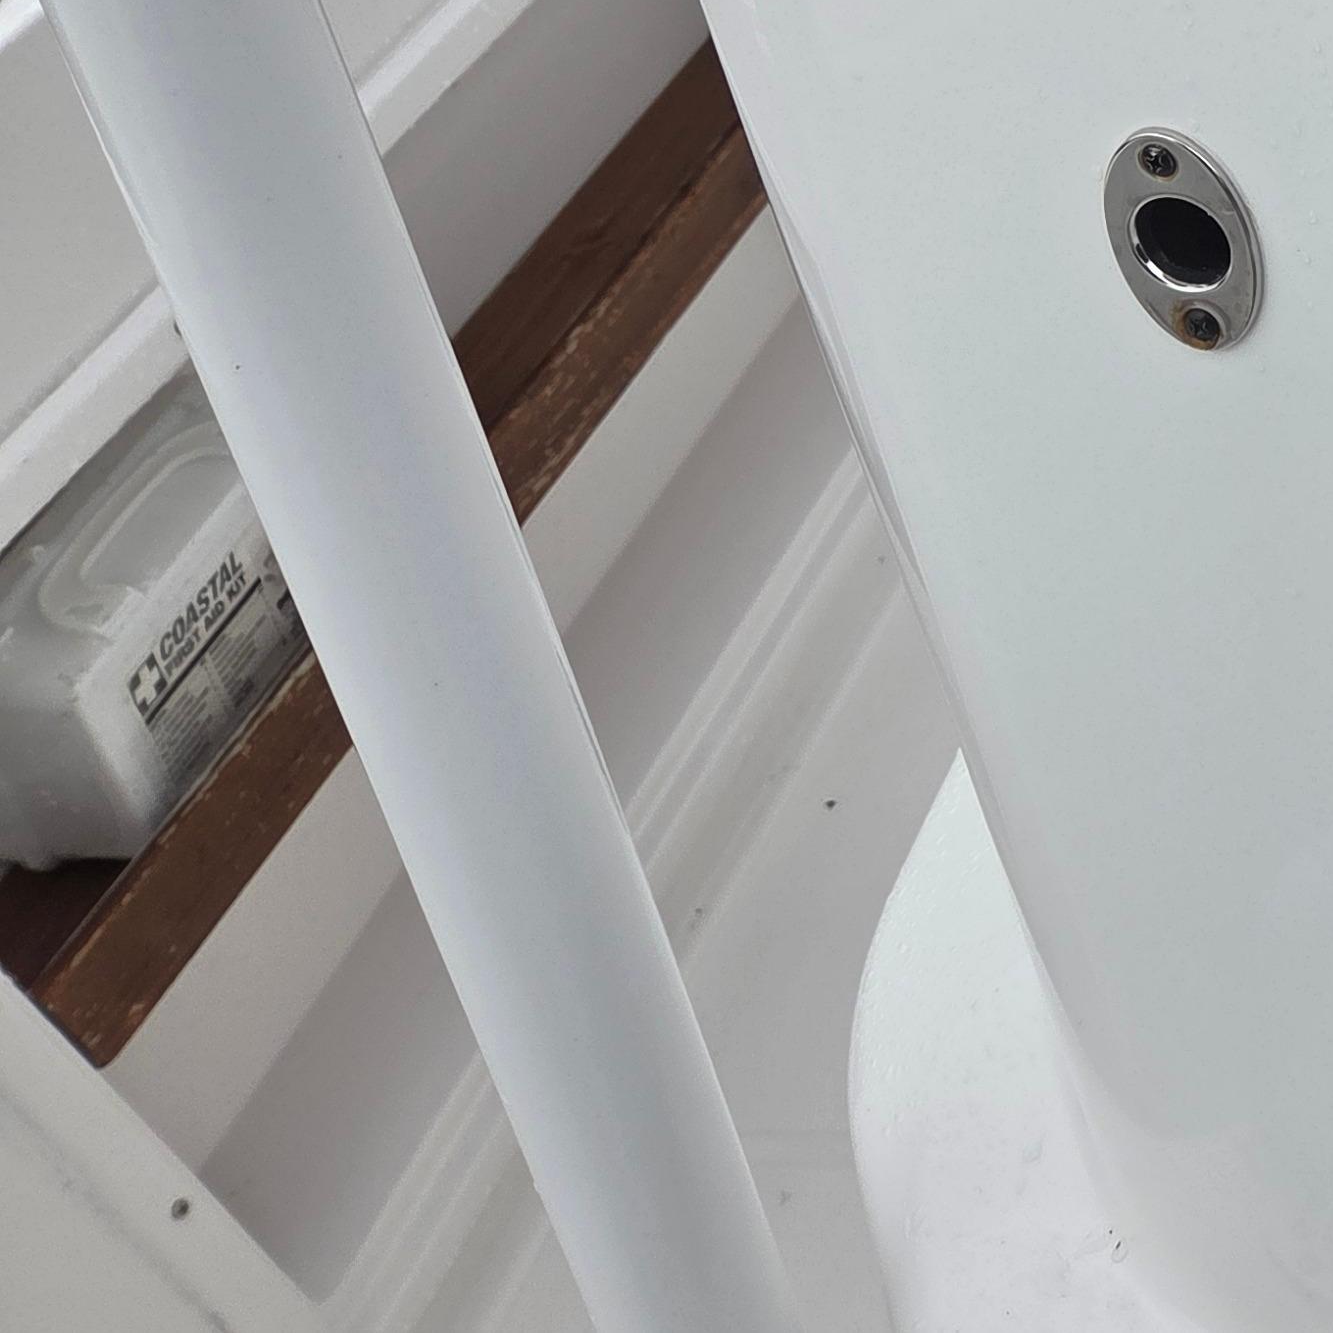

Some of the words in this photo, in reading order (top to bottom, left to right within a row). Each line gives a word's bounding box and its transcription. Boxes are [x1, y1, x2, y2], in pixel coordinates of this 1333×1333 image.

[160, 551, 243, 661] COASTAL
[164, 627, 201, 676] FIRST
[204, 602, 225, 632] AID
[226, 571, 246, 603] KIT
